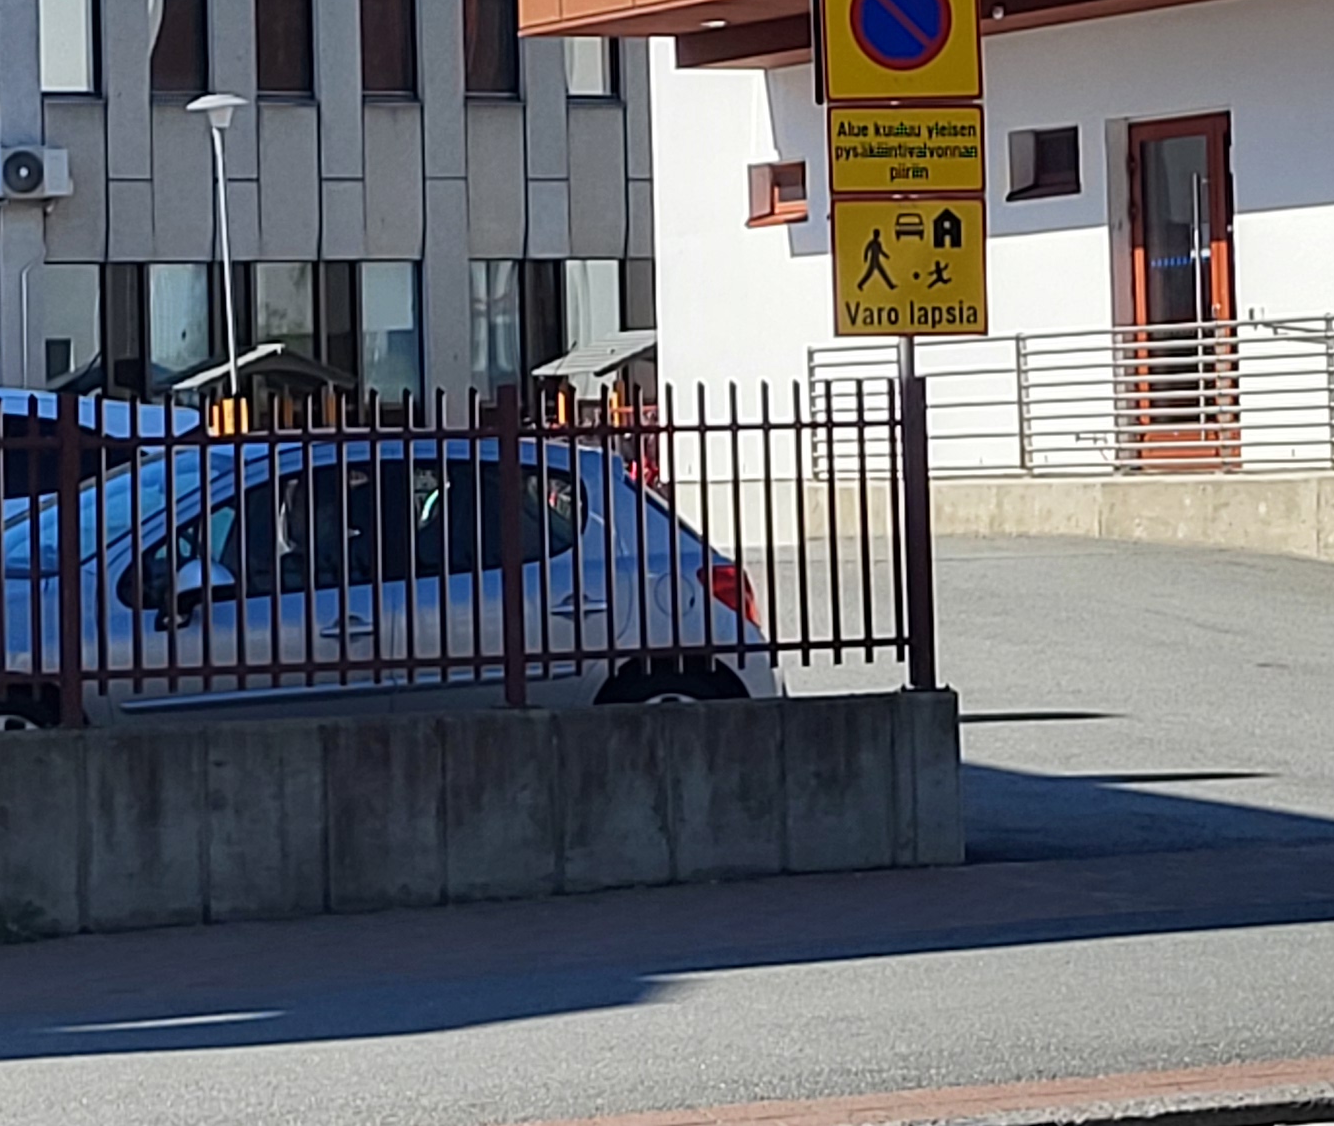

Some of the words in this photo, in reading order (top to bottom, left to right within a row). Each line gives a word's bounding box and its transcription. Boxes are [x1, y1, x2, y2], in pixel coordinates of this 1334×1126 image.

[837, 121, 869, 137] Alue
[873, 121, 921, 137] kuuluu
[926, 121, 977, 140] yleisen
[845, 300, 900, 326] Varo
[909, 299, 978, 329] lapsia
